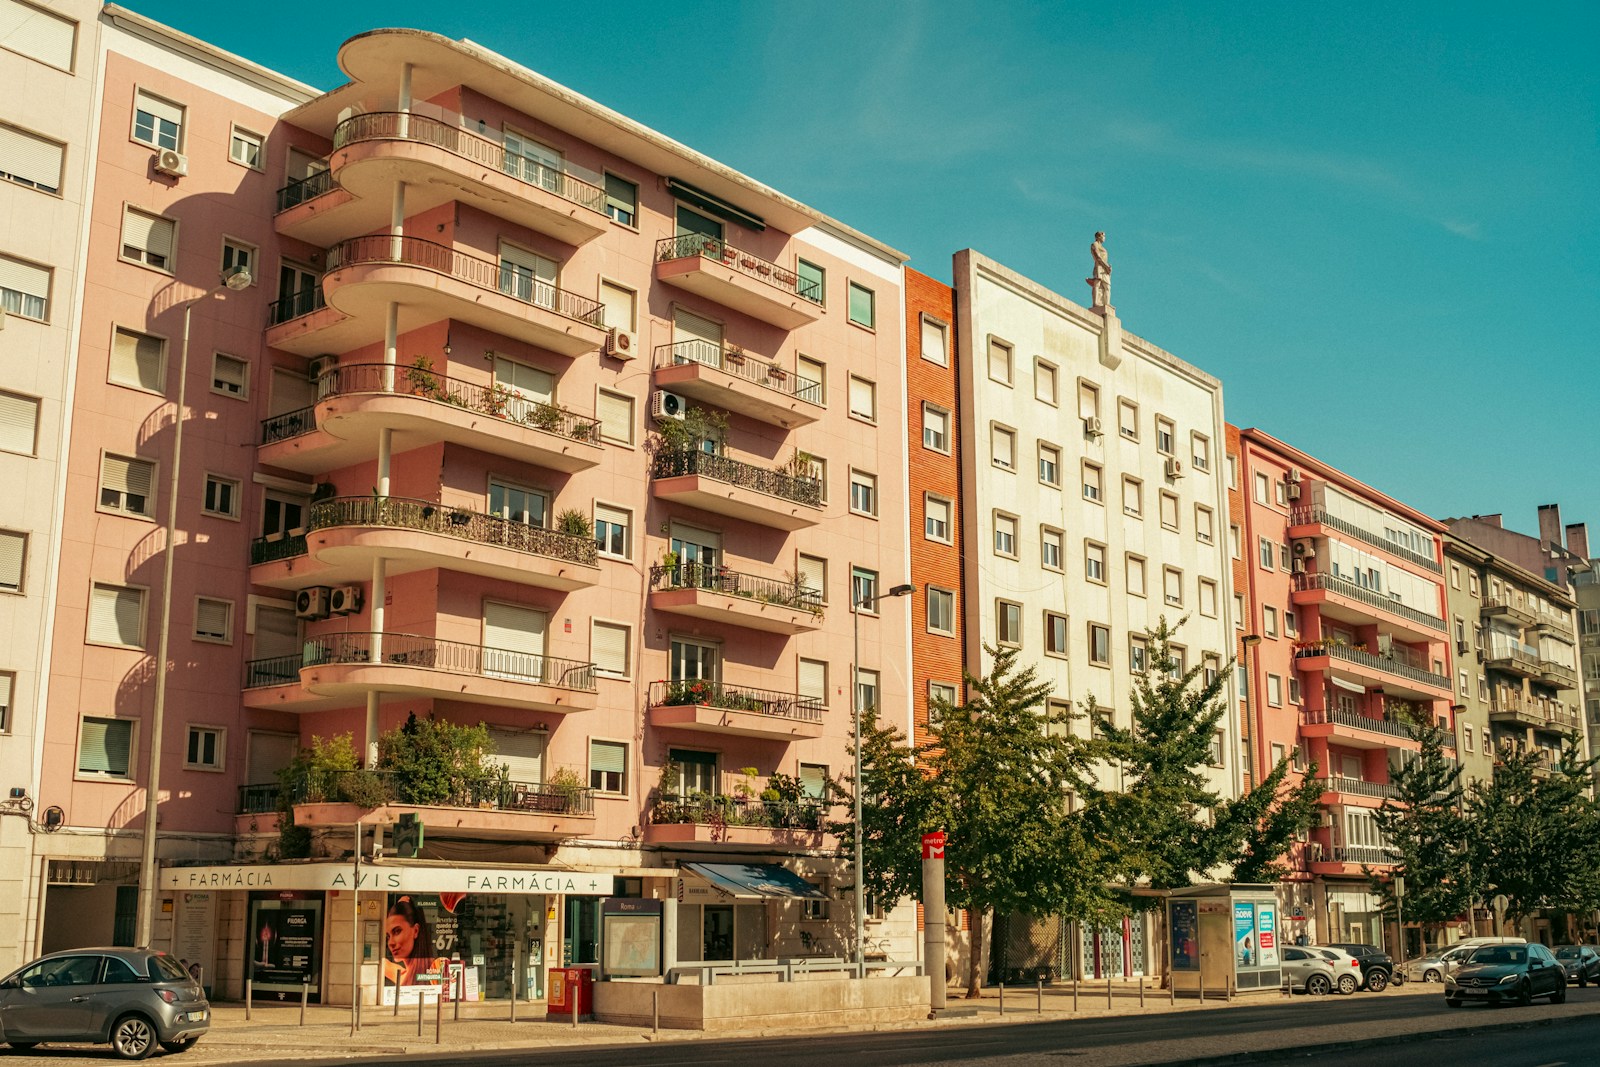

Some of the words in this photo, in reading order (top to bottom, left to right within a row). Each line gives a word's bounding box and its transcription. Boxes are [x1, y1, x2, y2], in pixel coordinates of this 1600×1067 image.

[190, 868, 272, 886] FARMÁCIA
[332, 873, 400, 888] AVIS
[468, 873, 576, 890] FARMÁCIA
